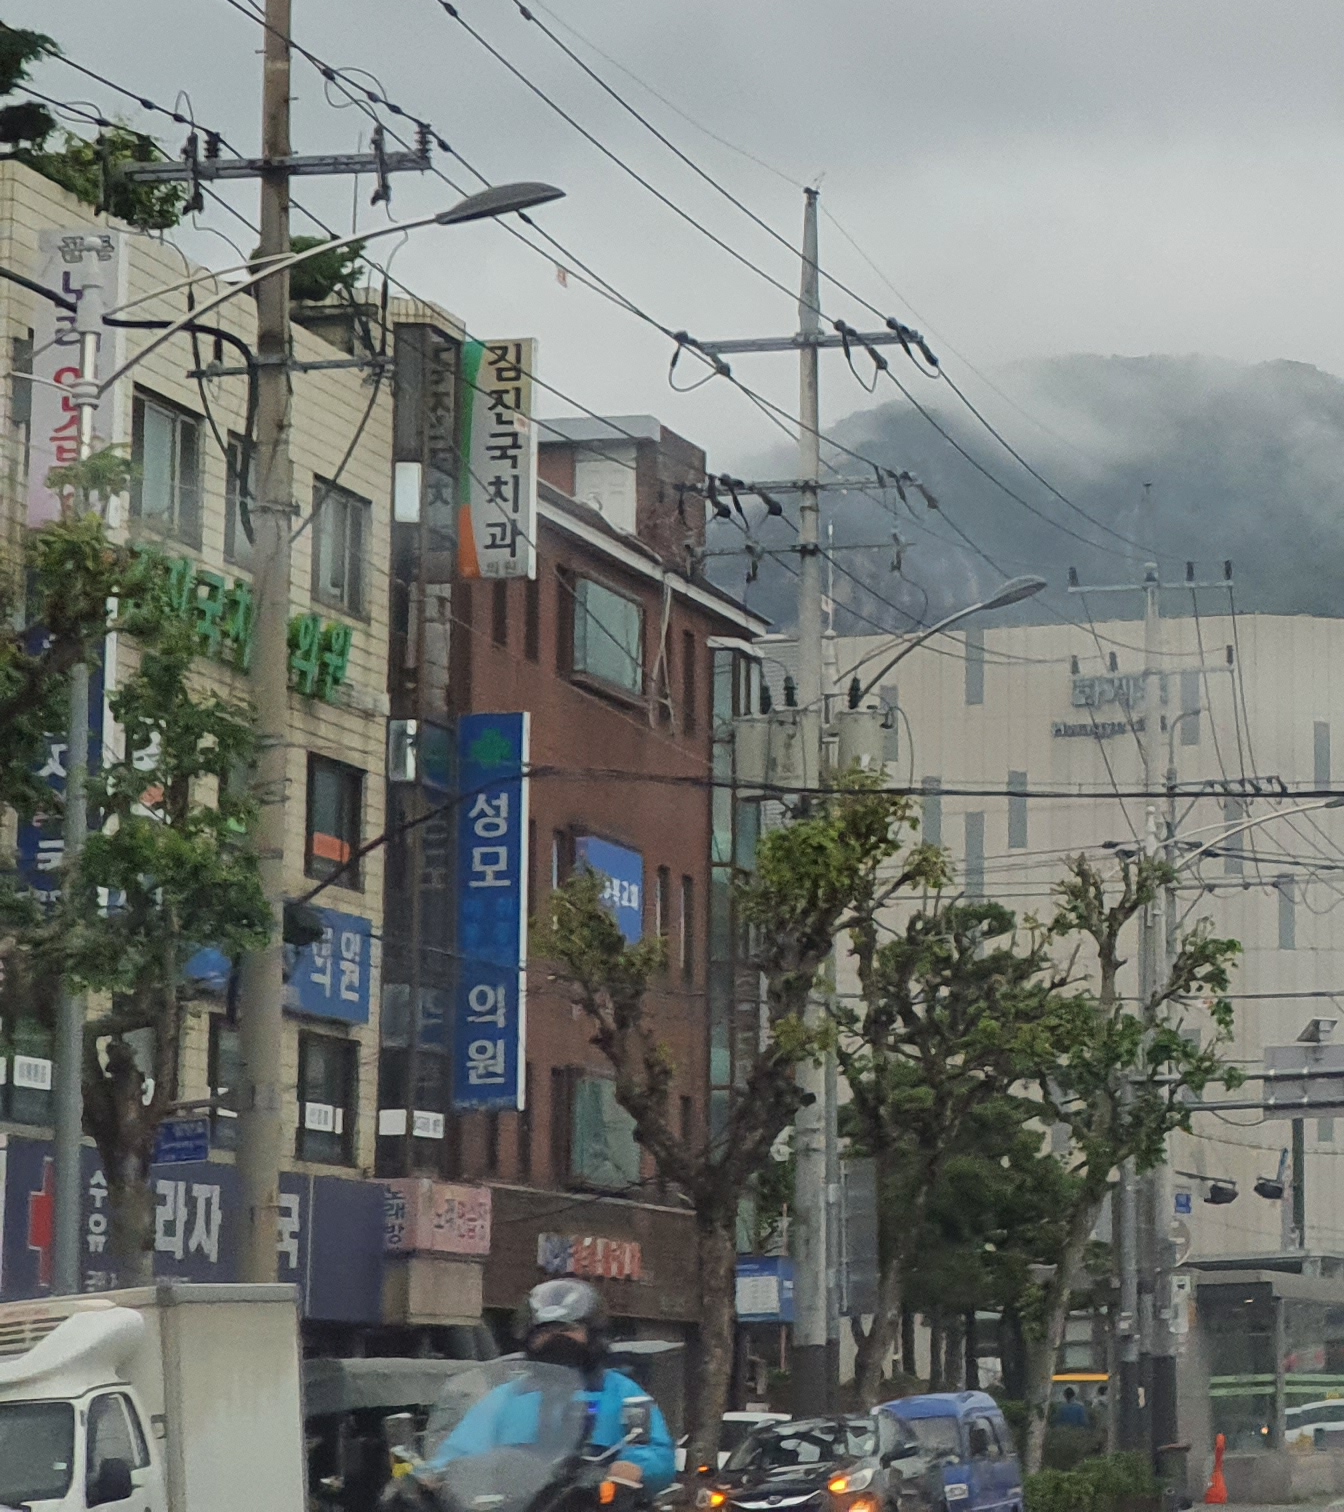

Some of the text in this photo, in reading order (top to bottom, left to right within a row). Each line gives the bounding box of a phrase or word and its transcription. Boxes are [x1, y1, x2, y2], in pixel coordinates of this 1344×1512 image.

[484, 343, 522, 558] 김진국치과
[467, 792, 512, 1085] 성모 의원
